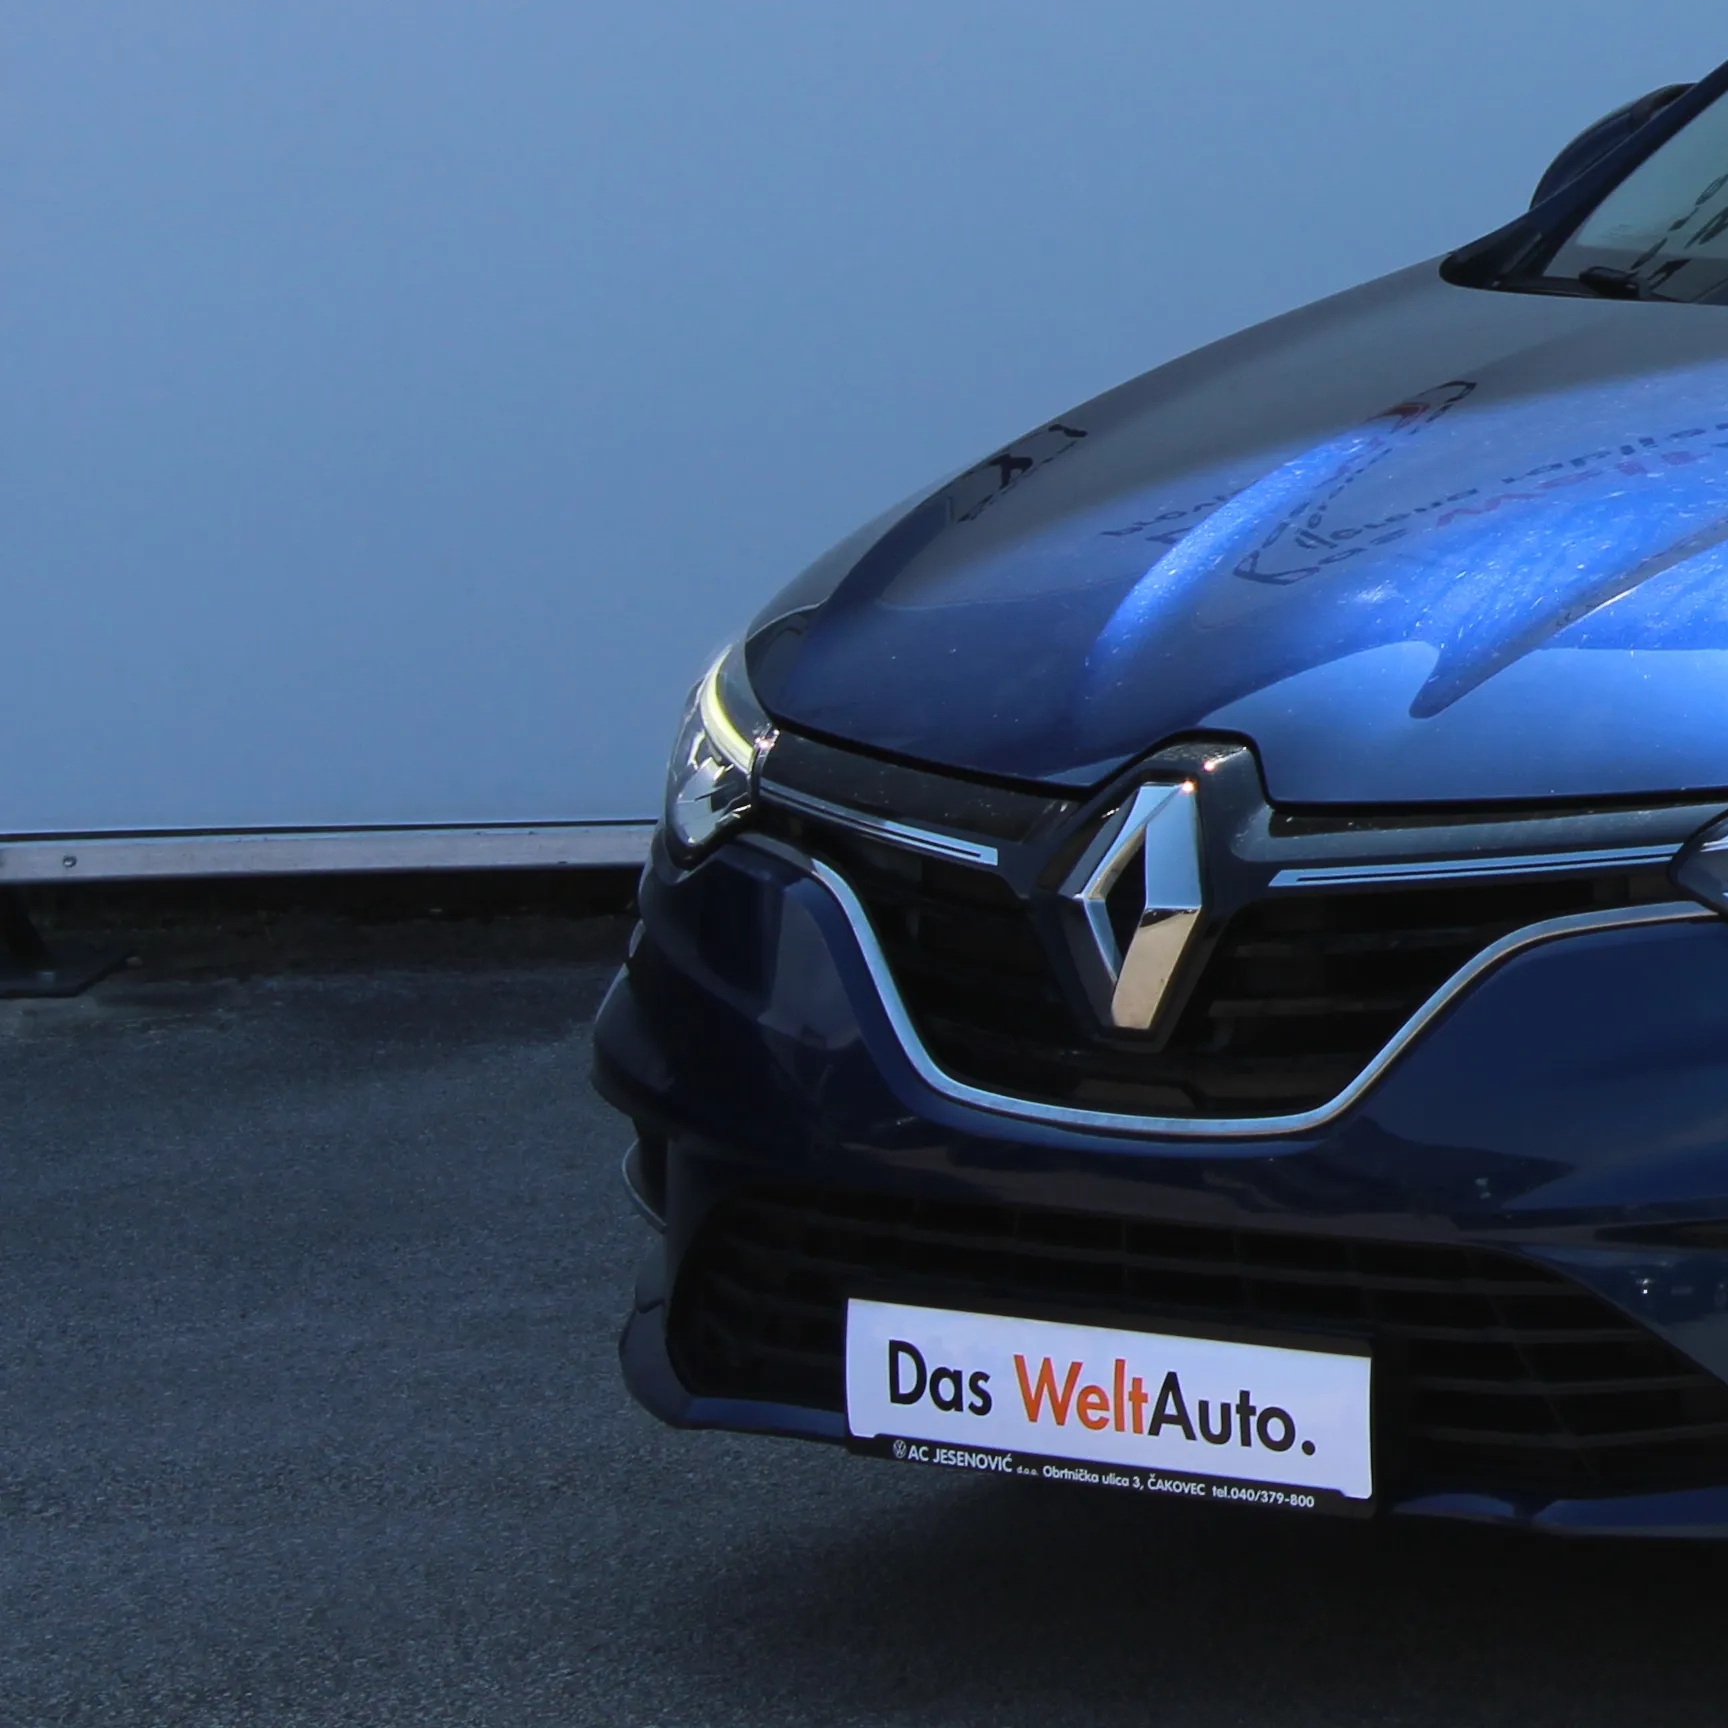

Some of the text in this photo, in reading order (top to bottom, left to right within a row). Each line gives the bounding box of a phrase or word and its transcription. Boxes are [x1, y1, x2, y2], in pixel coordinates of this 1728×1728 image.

[887, 1339, 1317, 1457] Das WeltAuto.
[907, 1444, 930, 1462] AC
[932, 1447, 1013, 1473] JESENOVIĆ
[1042, 1465, 1100, 1484] Obrtnička
[1102, 1472, 1130, 1487] ulica
[1132, 1475, 1145, 1491] 3,
[1147, 1472, 1206, 1496] ČAKOVEC
[1212, 1485, 1316, 1508] tel.040/379-800
